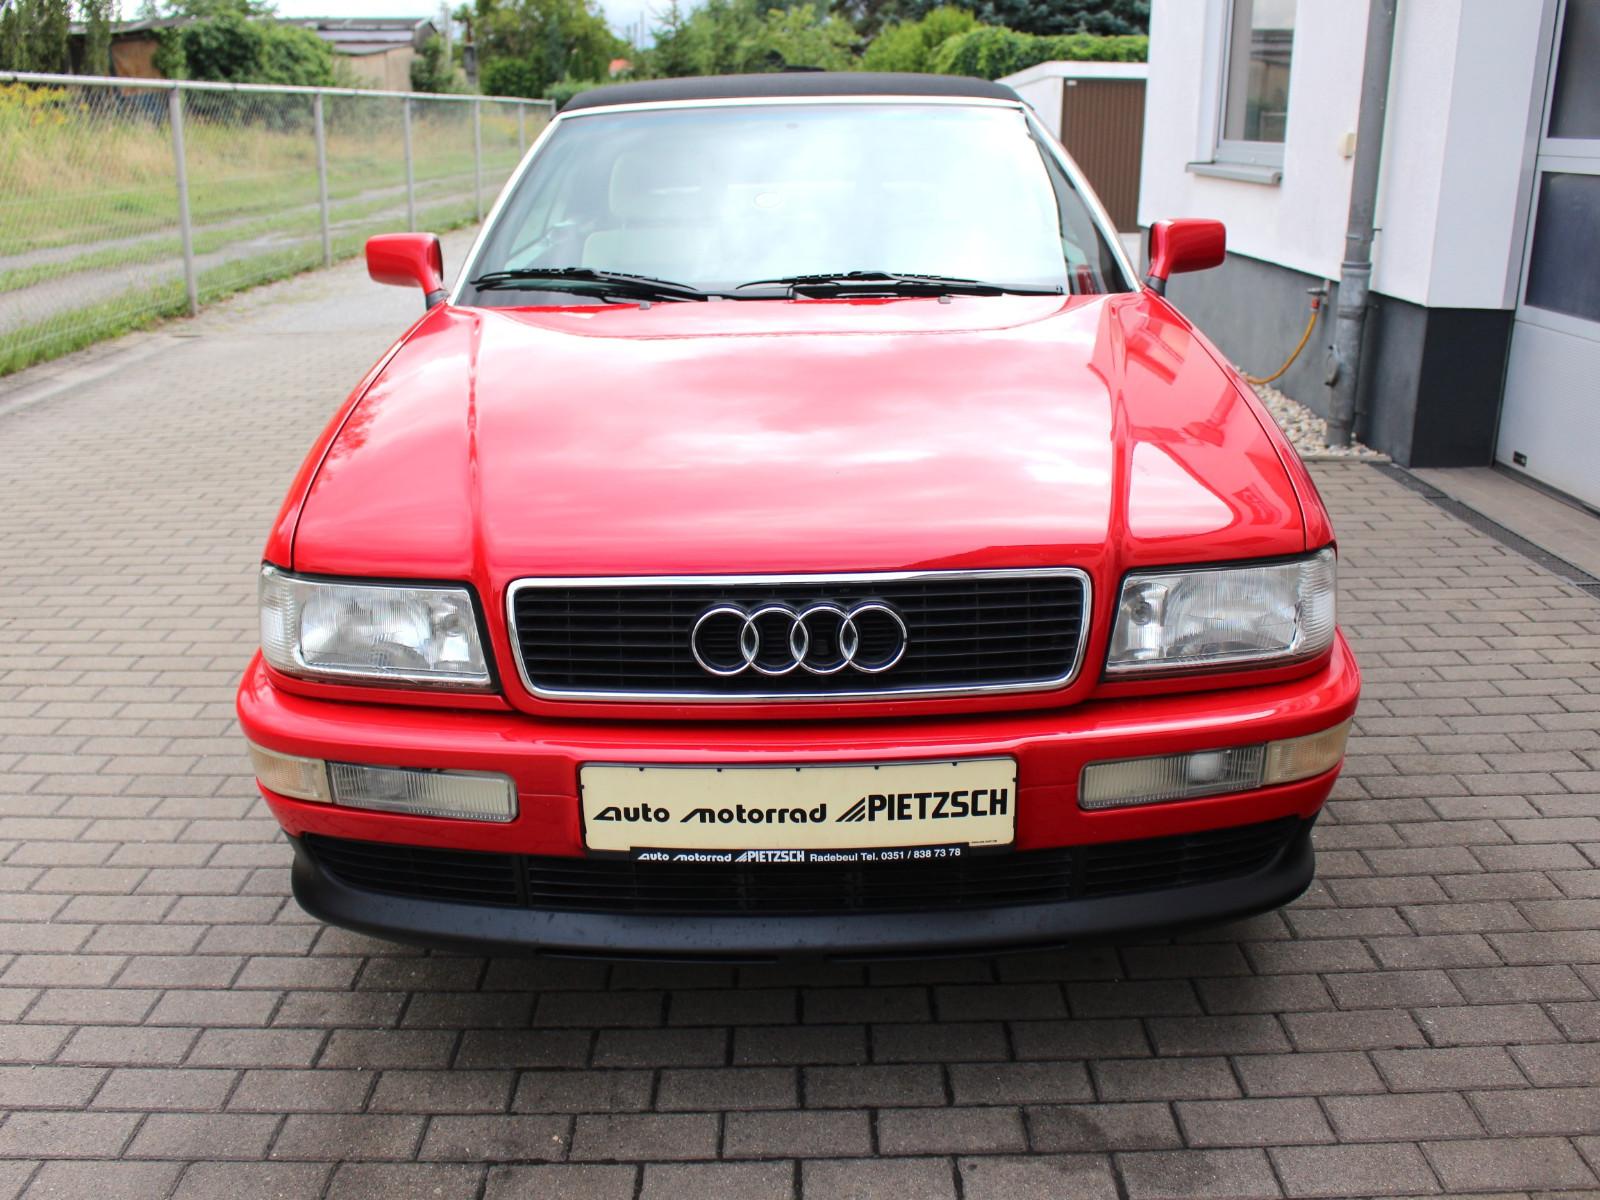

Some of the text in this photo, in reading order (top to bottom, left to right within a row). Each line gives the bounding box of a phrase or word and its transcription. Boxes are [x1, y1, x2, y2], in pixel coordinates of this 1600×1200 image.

[868, 788, 1008, 822] PIETZSCH
[747, 850, 805, 862] PIETZSCH
[810, 853, 858, 862] Radebeul
[860, 852, 879, 861] Tel.
[881, 851, 904, 861] 0351
[913, 850, 931, 859] 838
[934, 849, 946, 857] 73
[949, 848, 961, 856] 78
